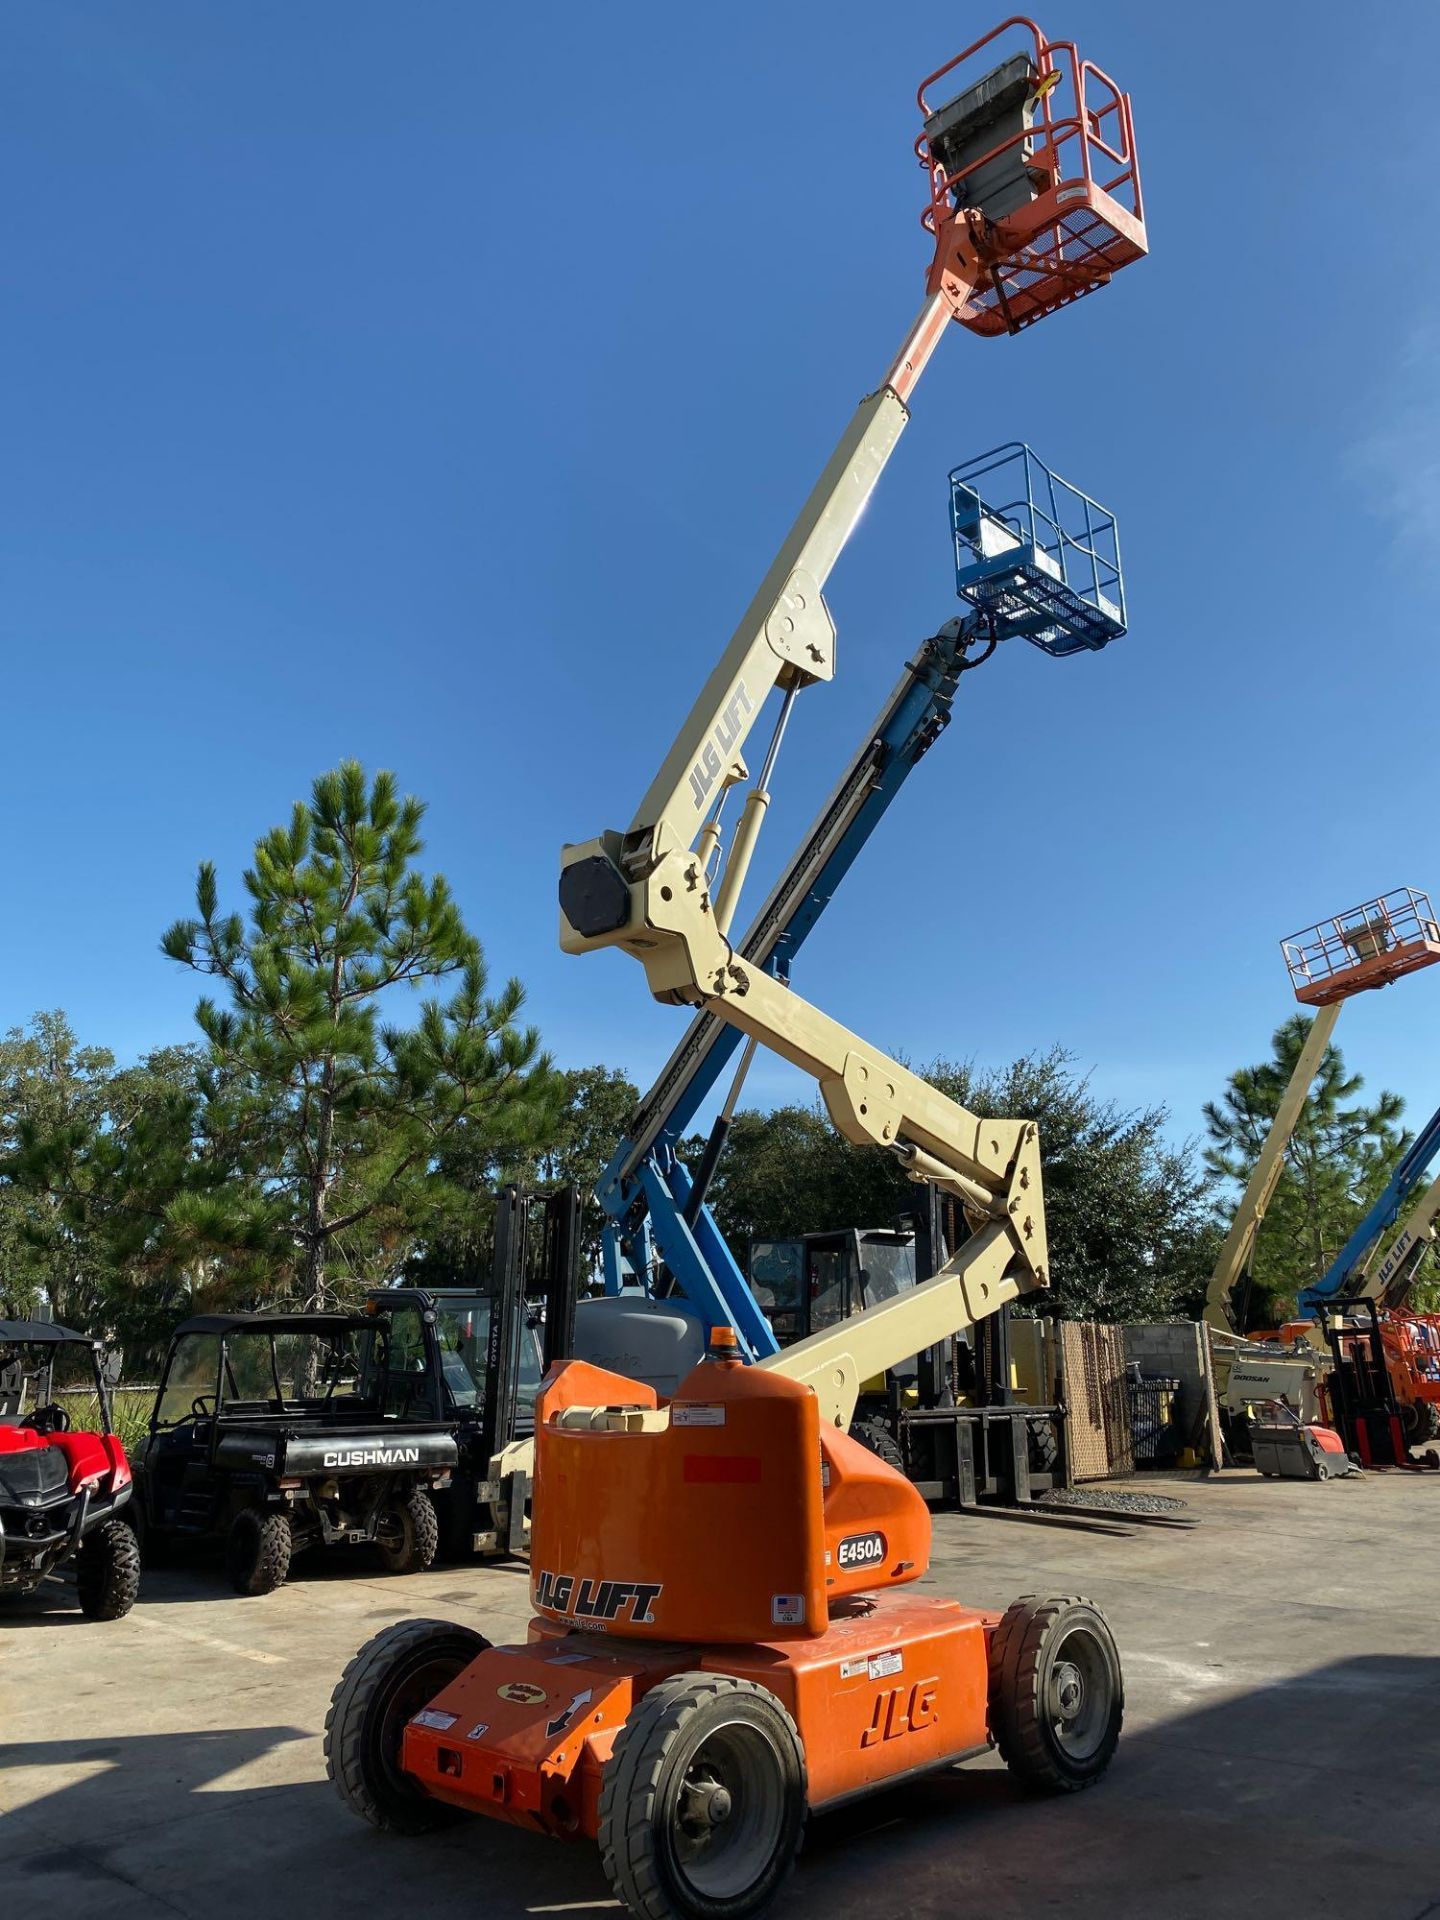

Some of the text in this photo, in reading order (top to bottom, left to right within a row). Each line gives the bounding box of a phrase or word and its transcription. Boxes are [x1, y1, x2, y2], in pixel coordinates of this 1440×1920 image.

[688, 679, 754, 812] JLG LIFT
[1378, 1230, 1411, 1285] JLG LIFT
[490, 1325, 499, 1369] TOYOTA
[1233, 1374, 1270, 1383] DOOSAN
[323, 1447, 420, 1468] CUSHMAN
[838, 1537, 883, 1565] E450A
[535, 1570, 576, 1614] JLG
[860, 1676, 940, 1750] JLG
